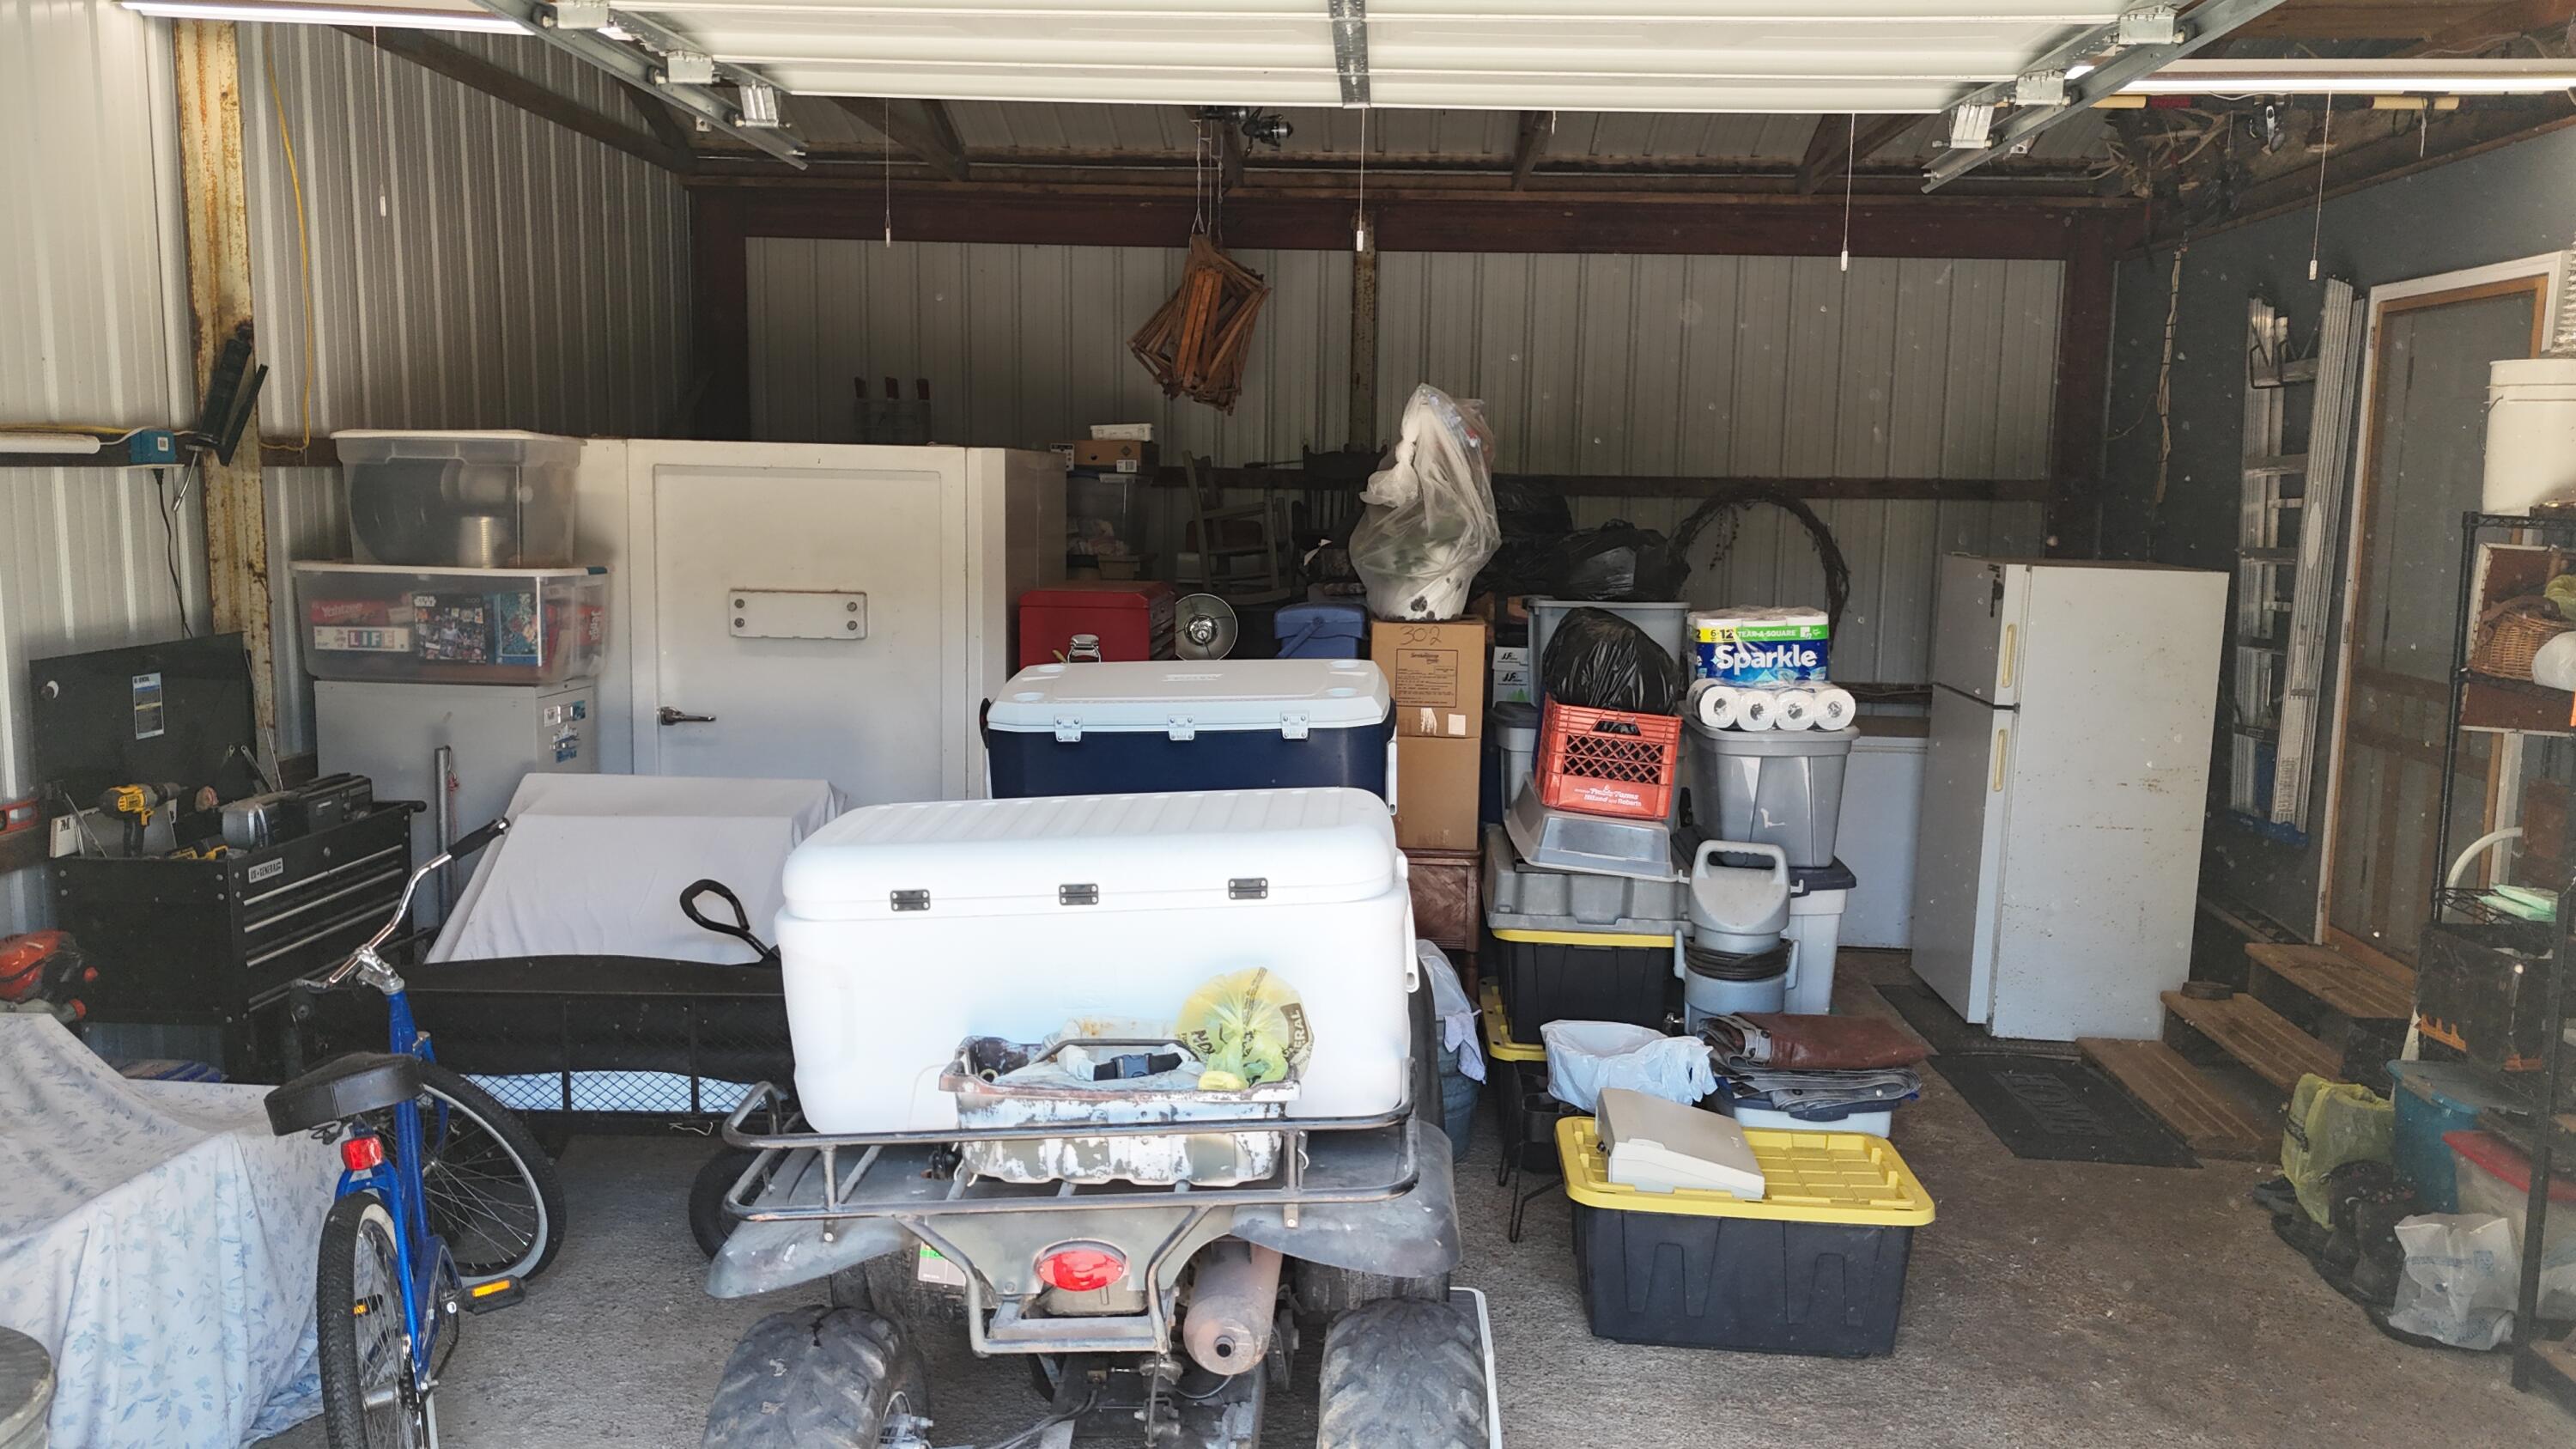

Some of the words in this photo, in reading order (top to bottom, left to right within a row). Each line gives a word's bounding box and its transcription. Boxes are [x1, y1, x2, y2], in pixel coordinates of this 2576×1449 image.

[348, 630, 395, 648] LIFE
[1400, 625, 1442, 646] 302
[1721, 629, 1734, 639] 12
[1715, 644, 1818, 676] Sparkle
